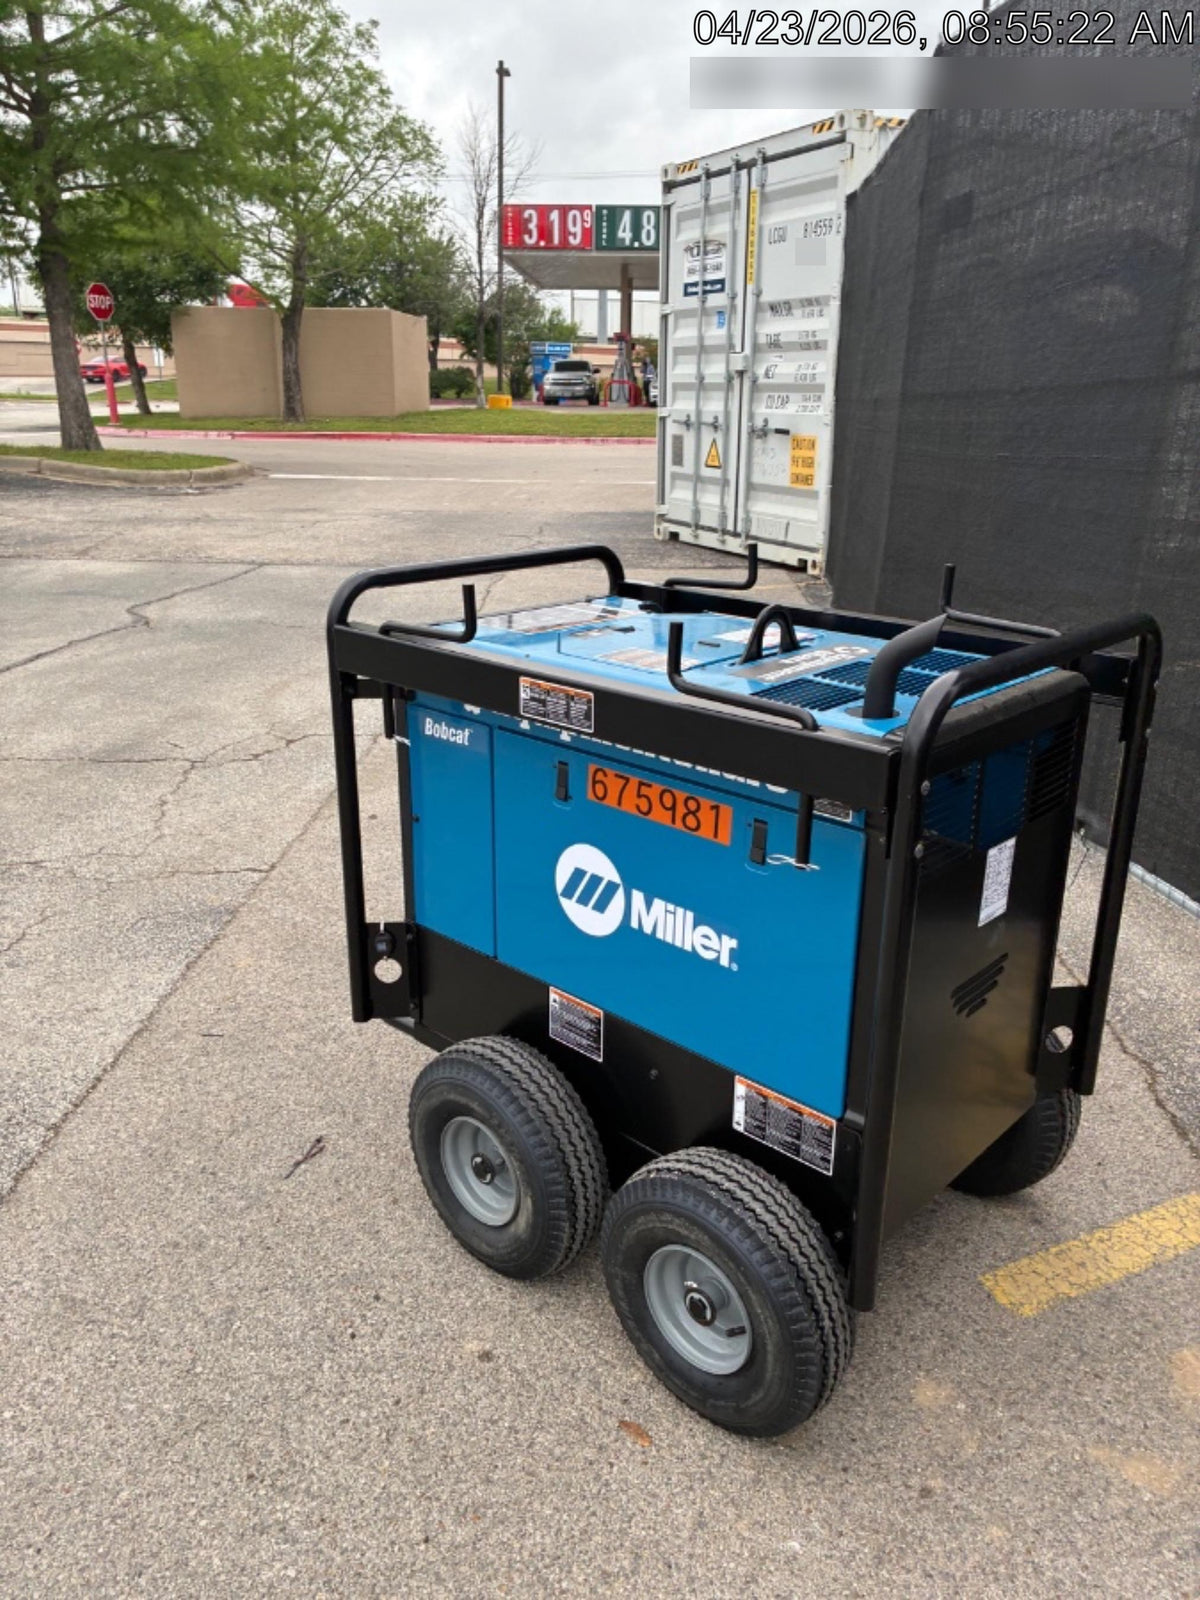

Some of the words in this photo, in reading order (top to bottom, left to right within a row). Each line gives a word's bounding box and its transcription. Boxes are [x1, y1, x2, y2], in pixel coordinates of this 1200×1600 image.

[89, 294, 113, 310] STOP
[424, 715, 471, 746] Bobcat
[590, 767, 722, 840] 675981
[630, 888, 738, 969] Miller
